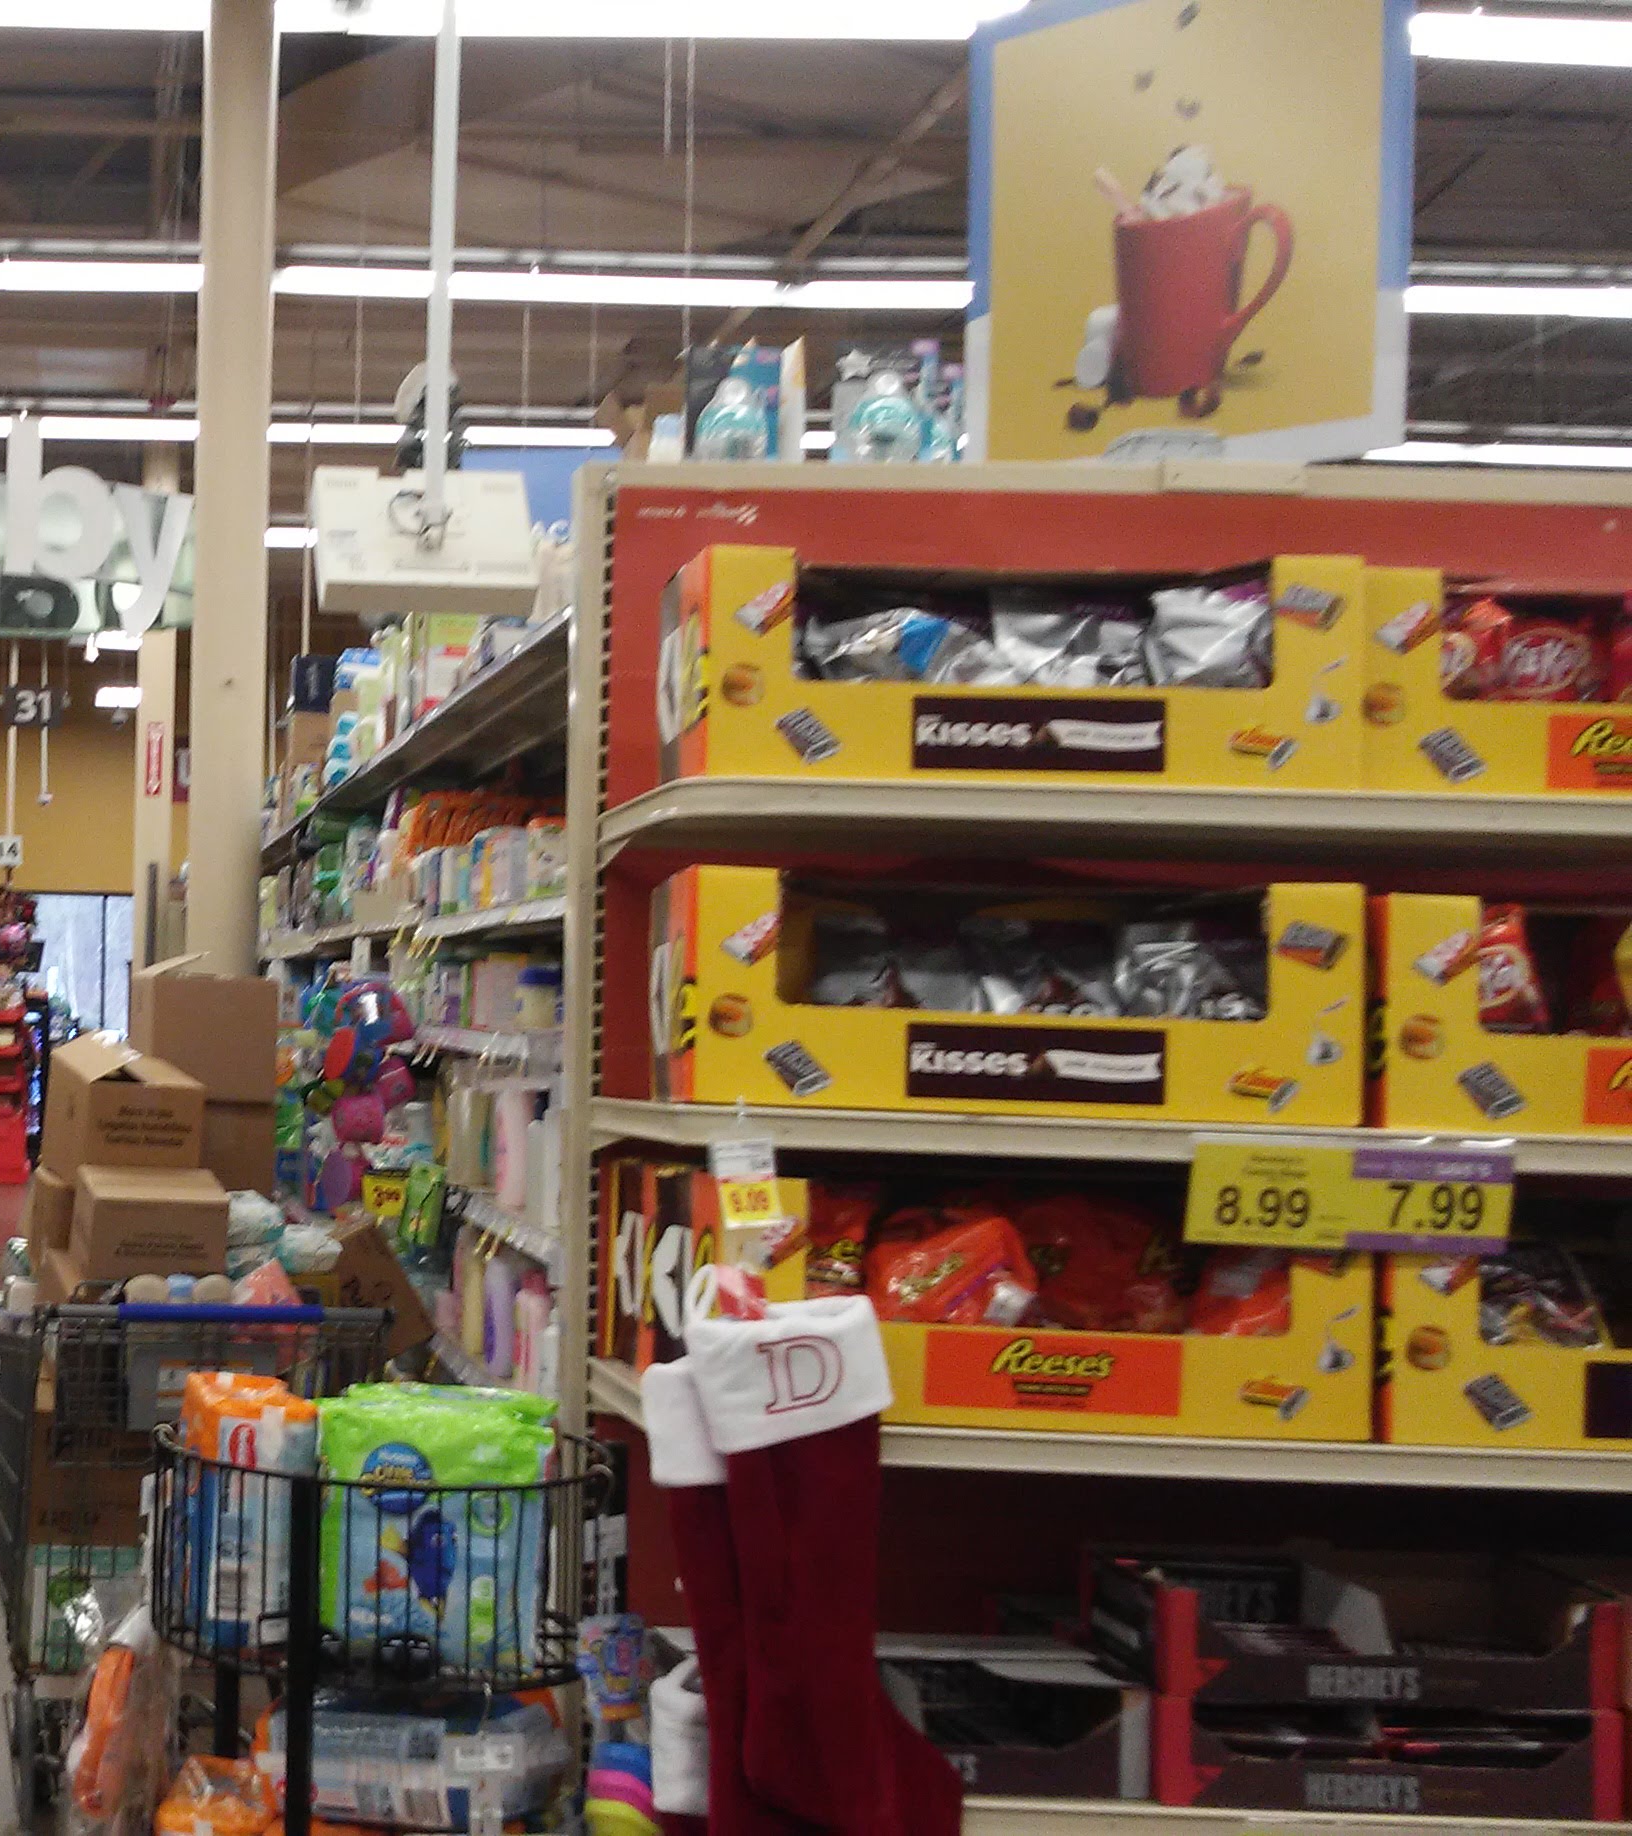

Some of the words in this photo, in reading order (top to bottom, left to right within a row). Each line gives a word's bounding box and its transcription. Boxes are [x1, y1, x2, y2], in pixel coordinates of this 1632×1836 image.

[14, 689, 52, 723] 31
[1215, 1185, 1311, 1229] 8.99
[1386, 1181, 1484, 1231] 7.99
[755, 1334, 844, 1414] D
[990, 1336, 1116, 1380] Reese's
[1306, 1664, 1419, 1700] HERSHEY'S
[1304, 1772, 1419, 1809] HERSHEY'S
